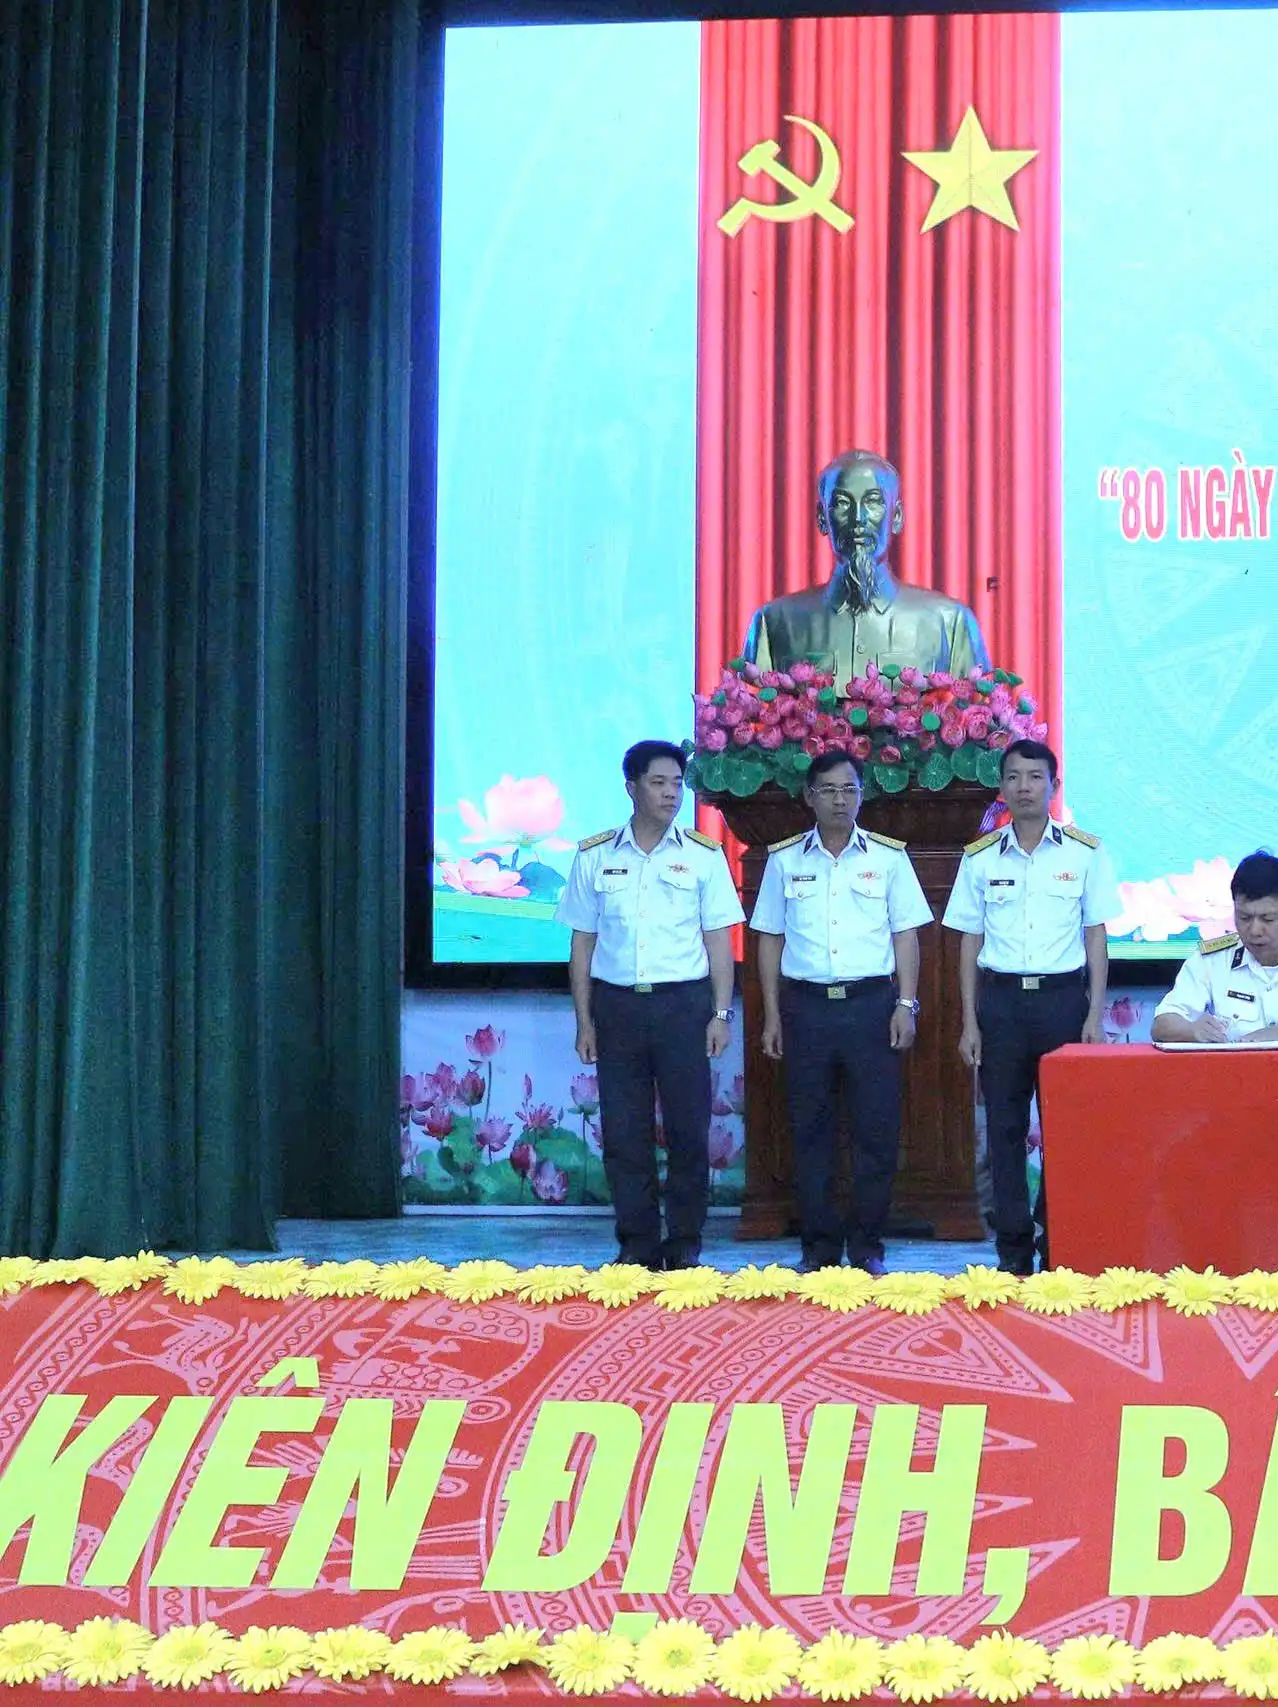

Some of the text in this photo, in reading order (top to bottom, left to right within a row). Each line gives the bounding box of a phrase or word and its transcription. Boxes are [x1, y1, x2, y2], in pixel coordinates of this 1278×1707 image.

[1100, 470, 1165, 539] “80
[1181, 451, 1274, 538] NGÀY
[0, 1357, 467, 1591] KIÊN
[480, 1400, 1030, 1641] ĐỊNH,
